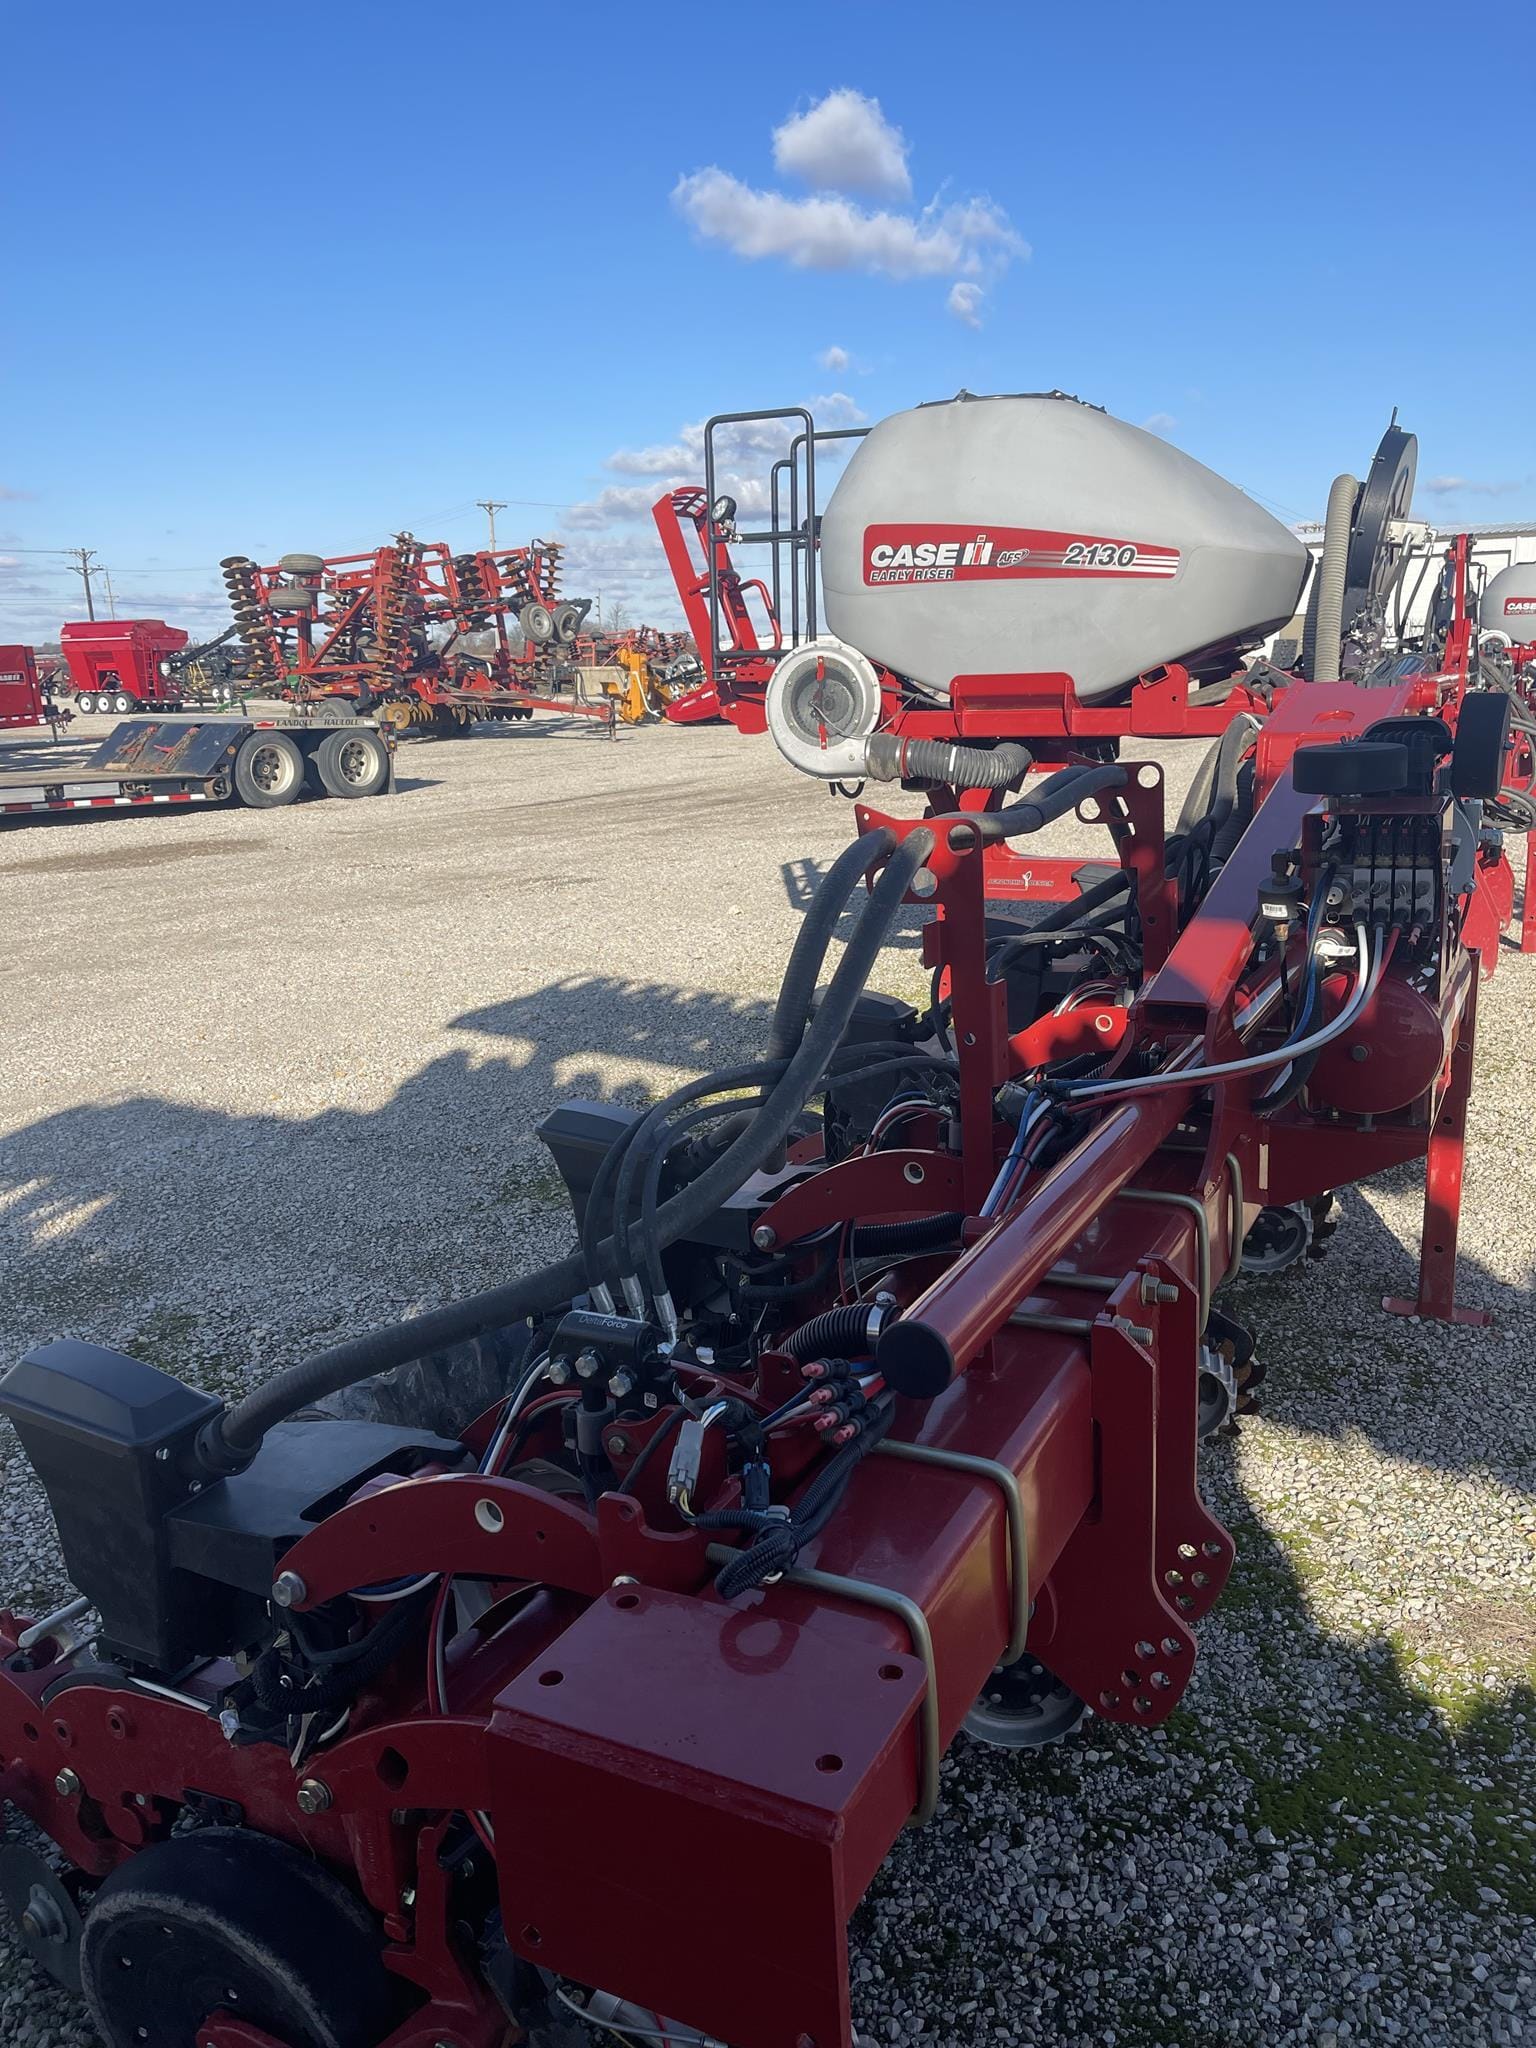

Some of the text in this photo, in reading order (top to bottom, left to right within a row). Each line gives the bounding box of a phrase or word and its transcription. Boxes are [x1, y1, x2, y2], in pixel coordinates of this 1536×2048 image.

[870, 543, 960, 568] CASE
[998, 551, 1023, 564] AFS
[1064, 542, 1138, 568] 2130
[870, 567, 955, 582] EARLY RISER
[579, 1314, 629, 1330] DeltaForce
